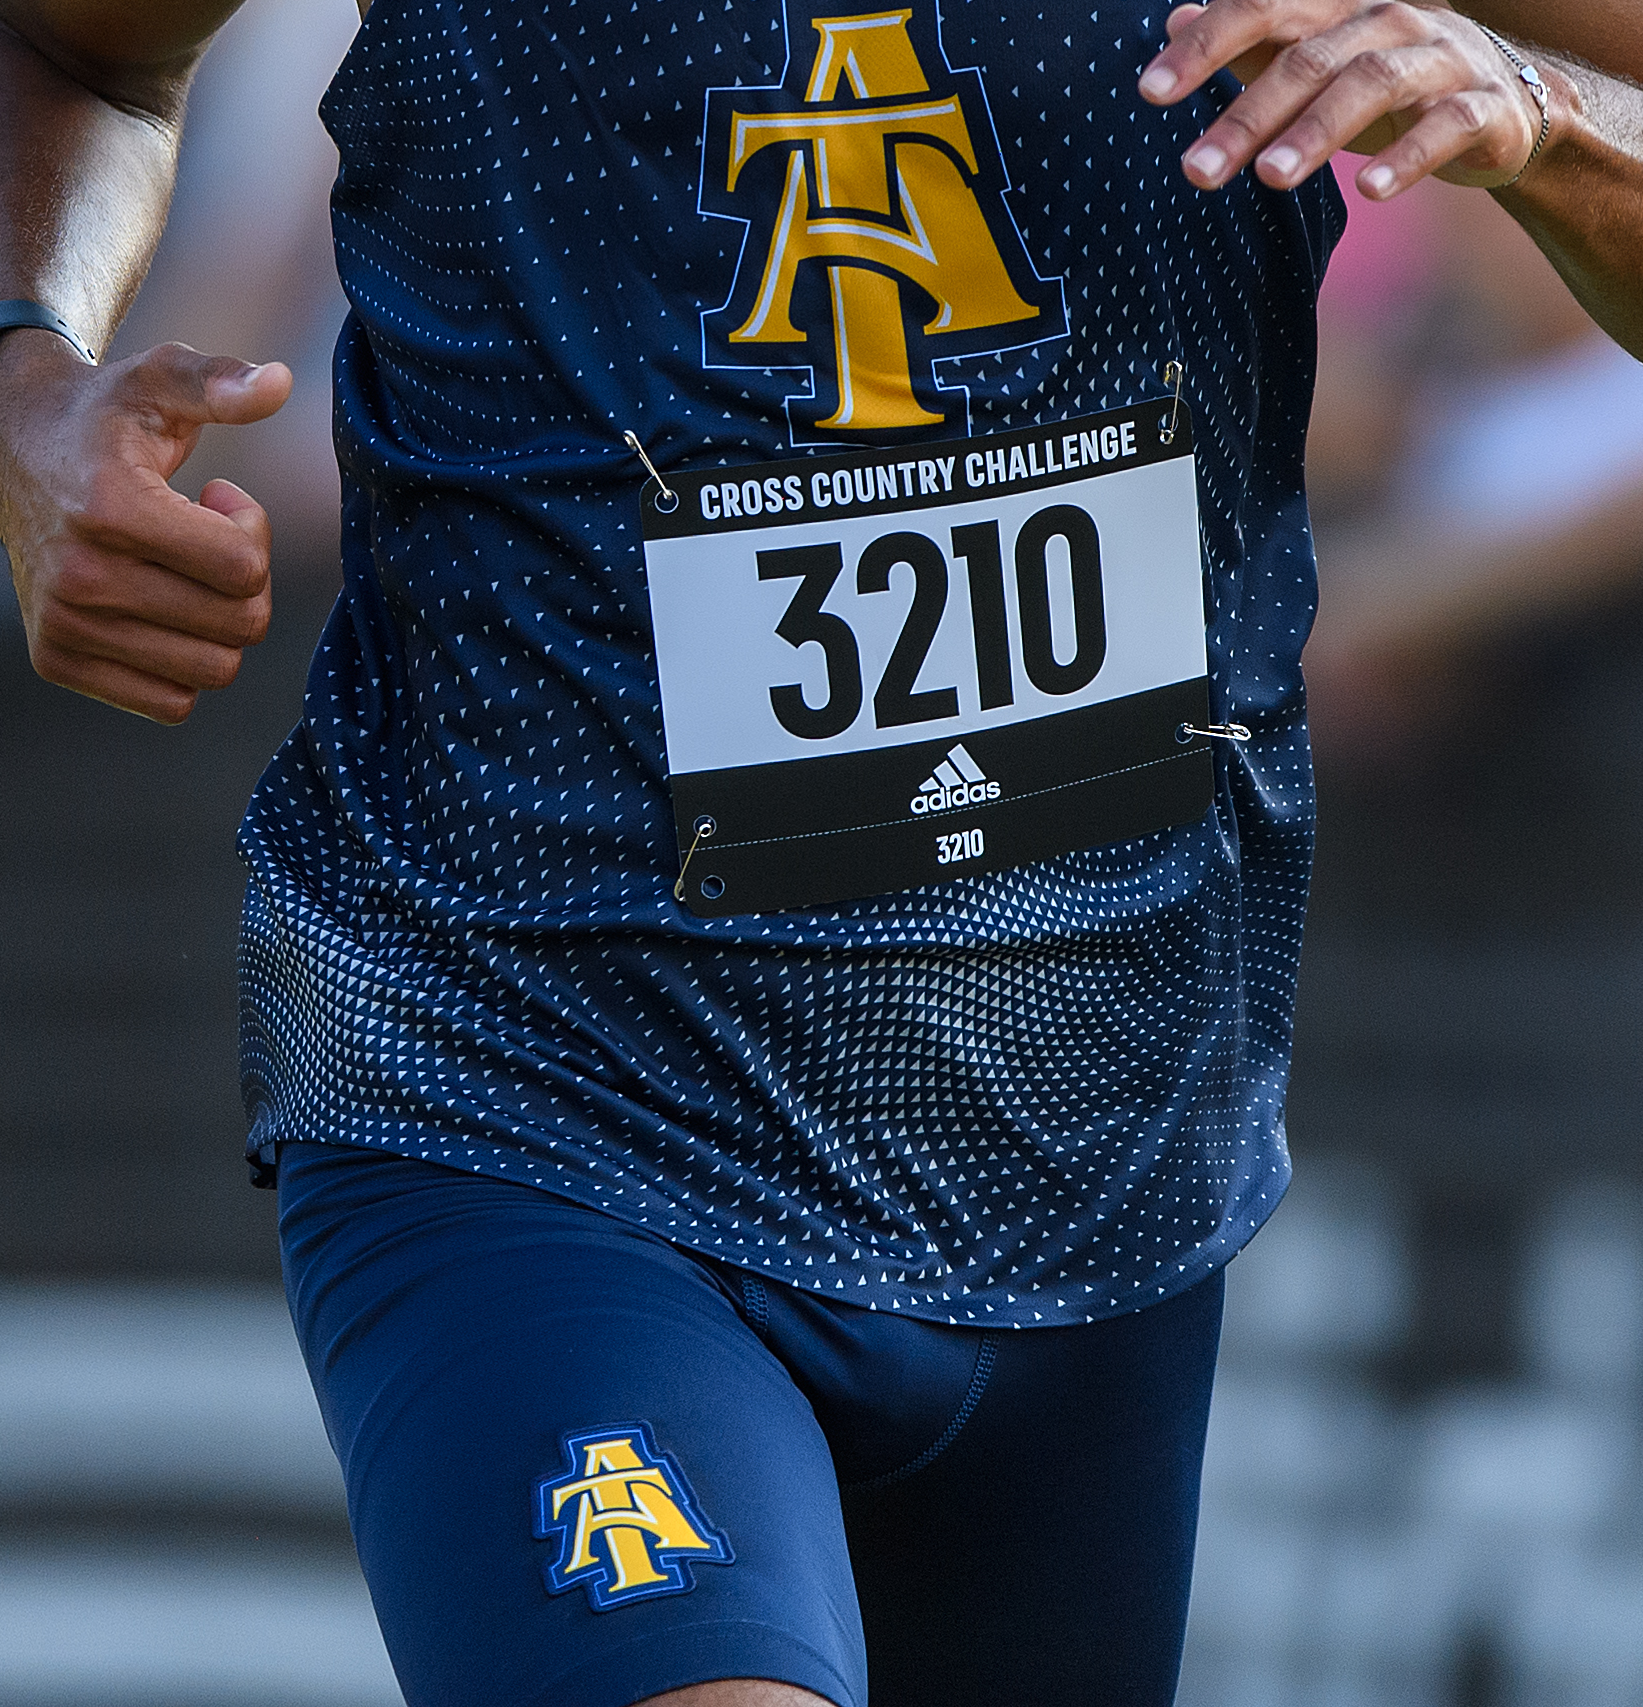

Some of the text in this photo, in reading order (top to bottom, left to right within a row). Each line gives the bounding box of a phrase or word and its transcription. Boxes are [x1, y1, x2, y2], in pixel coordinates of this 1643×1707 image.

[700, 421, 1138, 520] CROSS COUNTRY CHALLENGE
[755, 503, 1108, 740] 3210
[910, 777, 1001, 814] adidas
[936, 828, 985, 864] 3210
